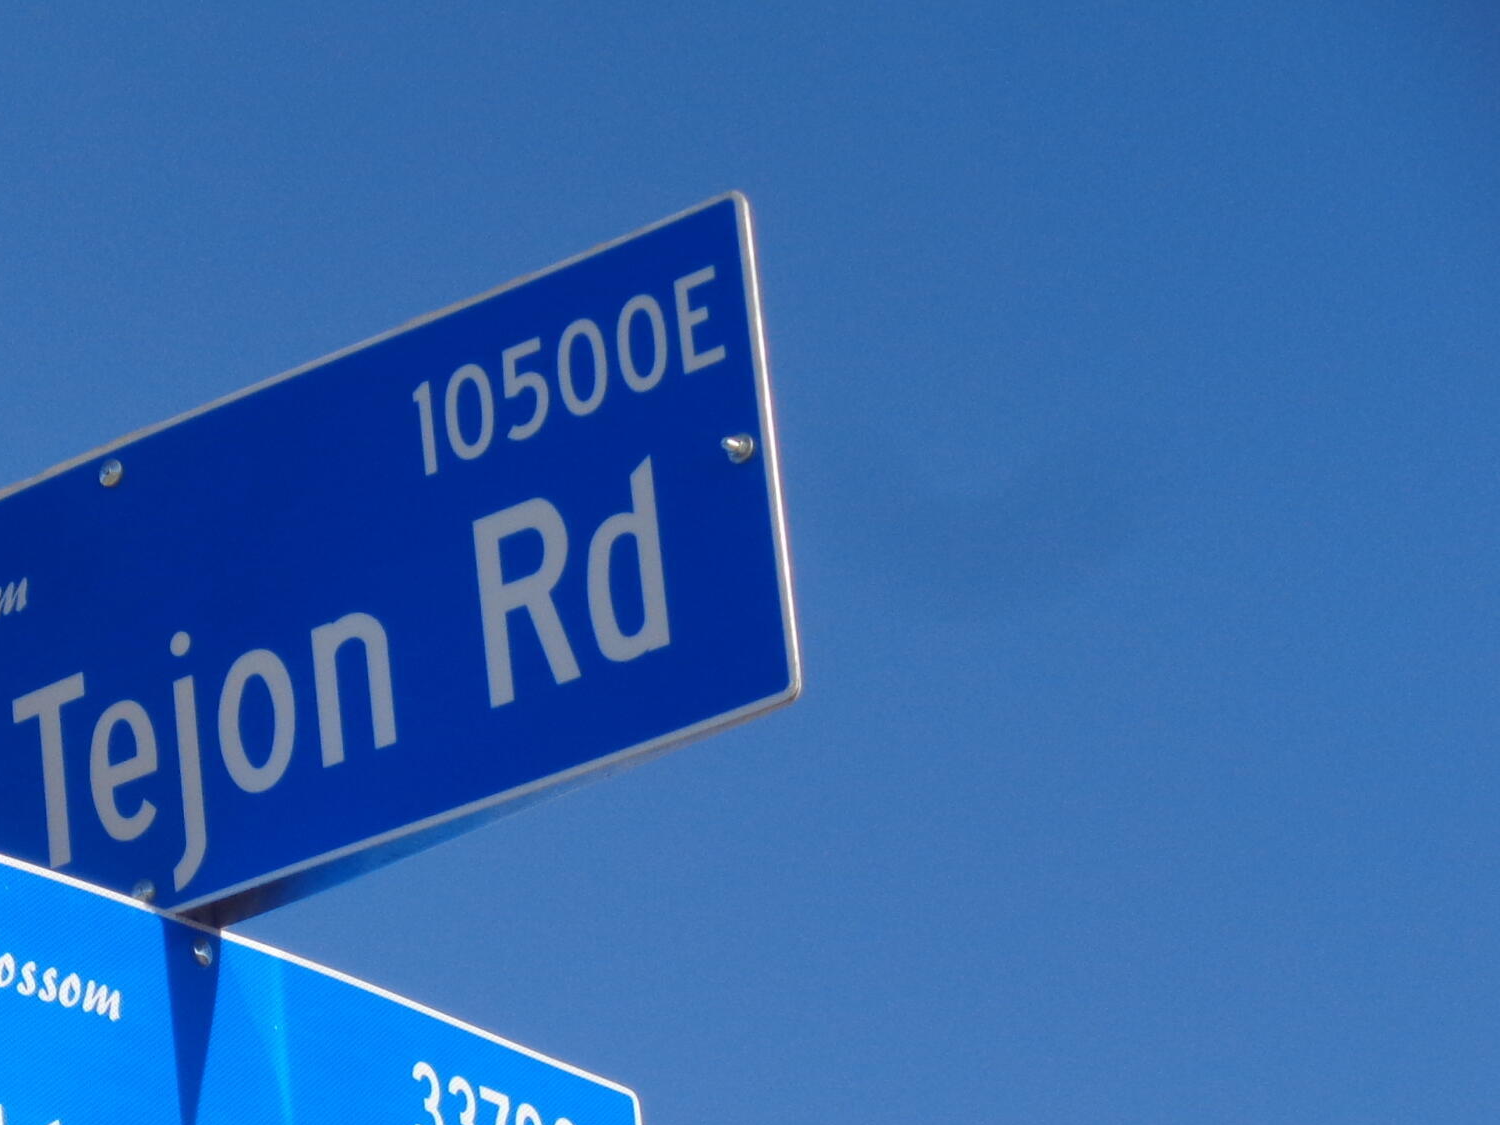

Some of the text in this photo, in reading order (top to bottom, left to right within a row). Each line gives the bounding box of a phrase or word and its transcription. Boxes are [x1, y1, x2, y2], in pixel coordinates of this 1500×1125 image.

[412, 264, 726, 476] 10500E
[12, 454, 671, 892] Tejon Rd
